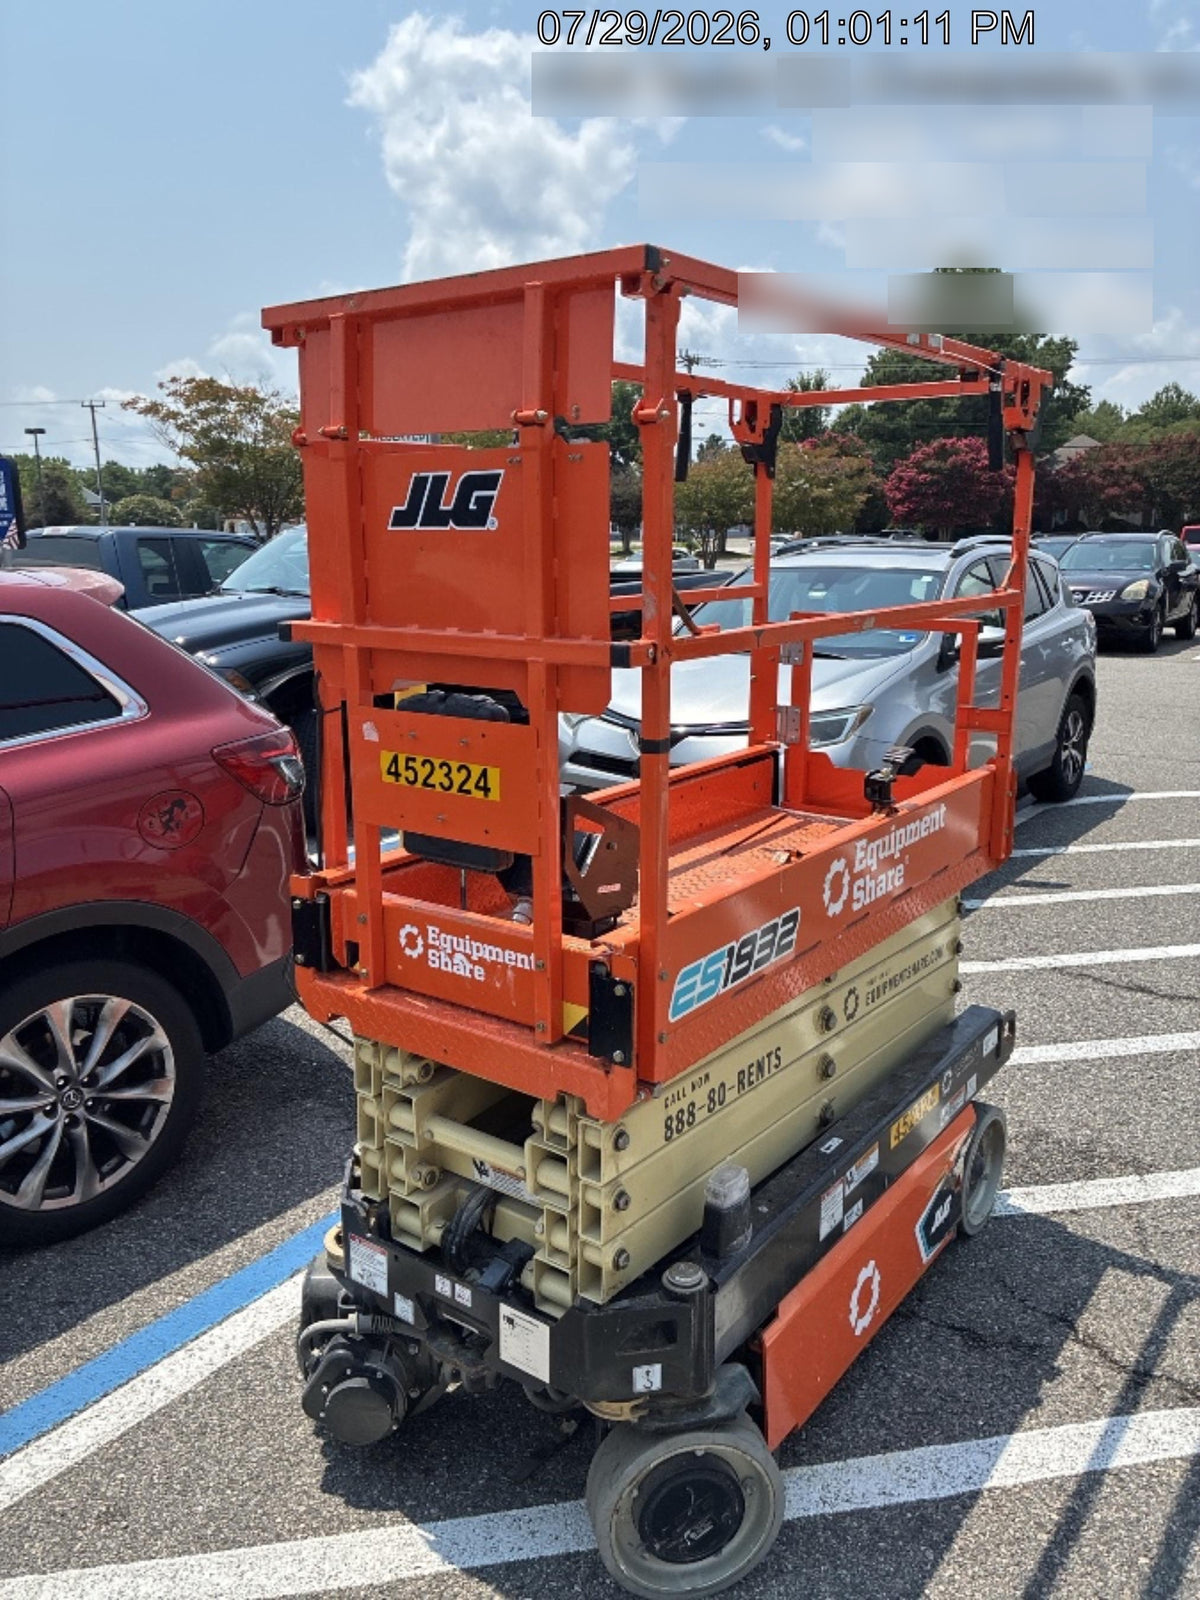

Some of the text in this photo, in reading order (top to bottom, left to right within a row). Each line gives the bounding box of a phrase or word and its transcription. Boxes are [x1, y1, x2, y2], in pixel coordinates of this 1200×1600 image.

[387, 468, 506, 530] JLG
[386, 752, 492, 799] 452324
[852, 802, 947, 874] Equipment
[852, 863, 905, 912] Share
[426, 924, 536, 971] Equipment
[427, 948, 486, 982] Share
[668, 906, 801, 1023] ES1932
[663, 1071, 711, 1110] CALL NOW
[663, 1045, 783, 1142] 888-80-RENTS
